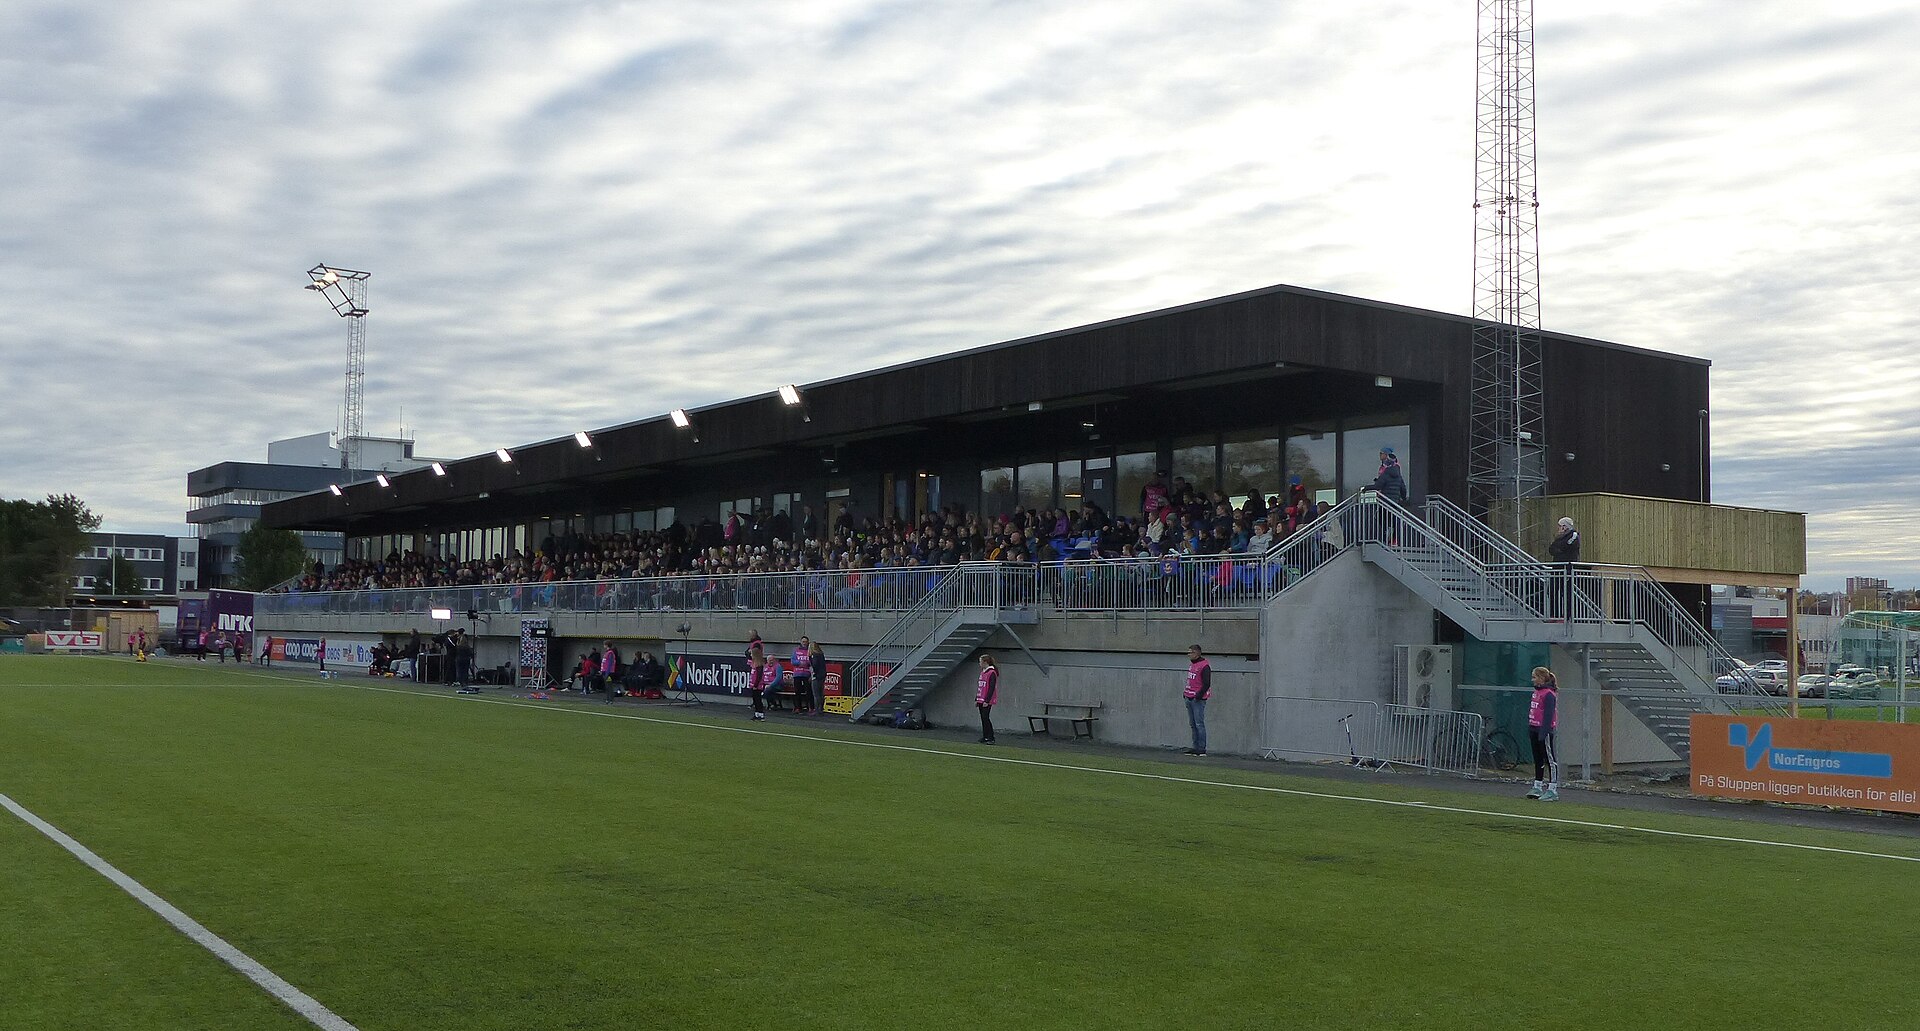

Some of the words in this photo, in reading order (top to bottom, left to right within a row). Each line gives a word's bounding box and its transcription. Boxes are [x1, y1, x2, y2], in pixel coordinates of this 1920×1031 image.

[48, 634, 99, 646] VG
[686, 661, 720, 686] Norsk
[1774, 752, 1840, 769] NorEngros
[1699, 775, 1714, 787] På
[1717, 777, 1765, 792] Sluppen
[1768, 780, 1803, 796] ligger
[1807, 783, 1863, 799] butikken
[1866, 788, 1886, 801] for
[1889, 791, 1916, 803] alle!
